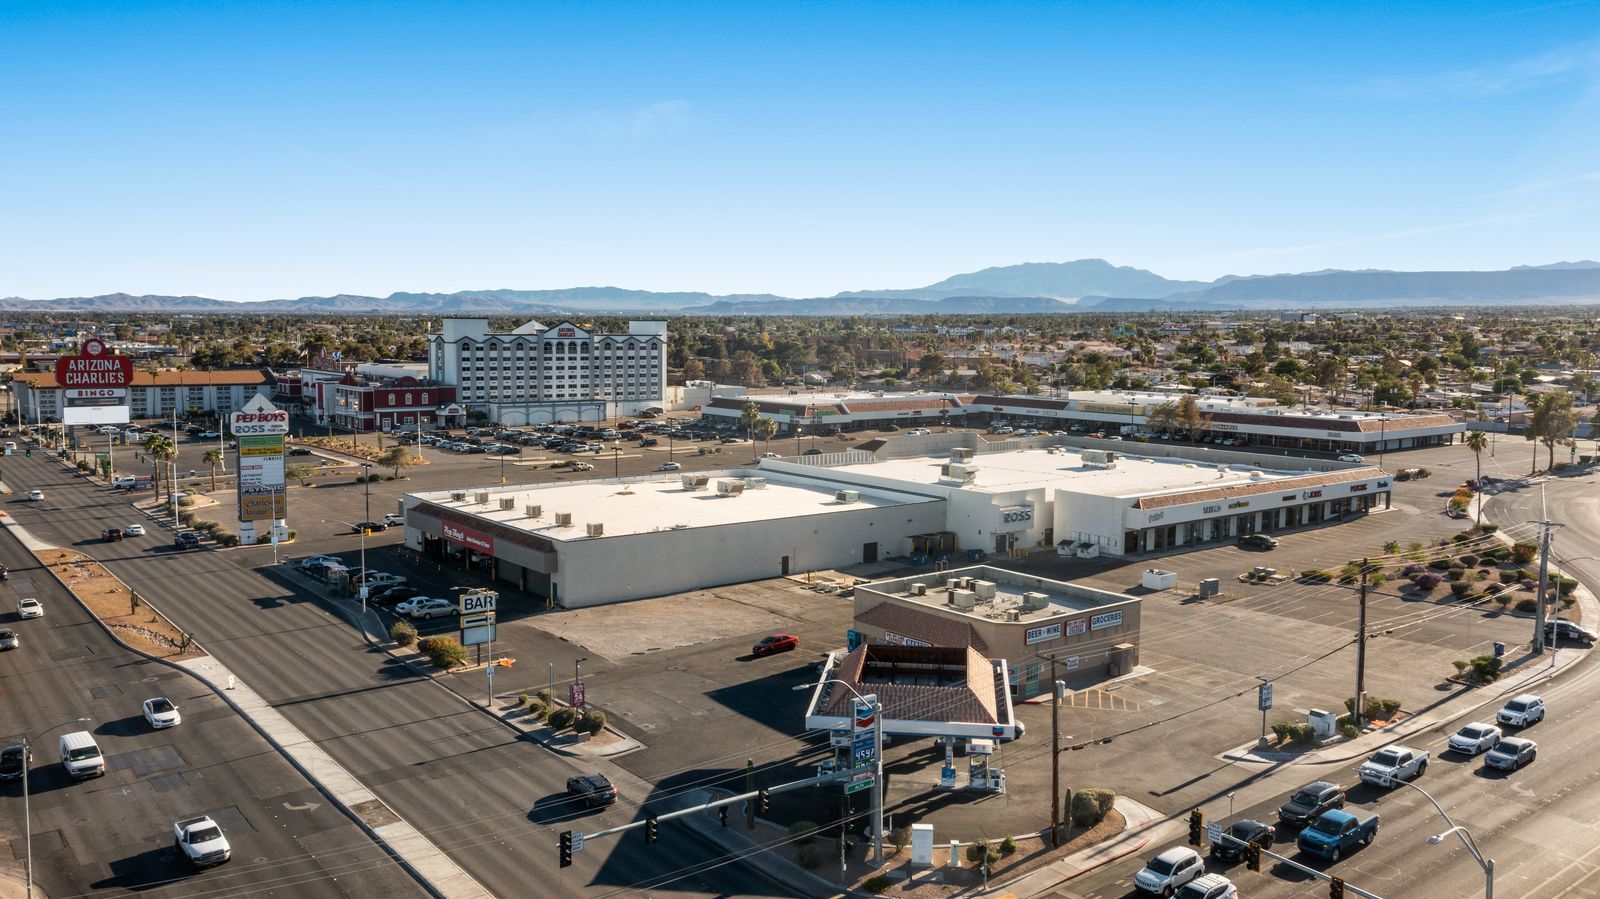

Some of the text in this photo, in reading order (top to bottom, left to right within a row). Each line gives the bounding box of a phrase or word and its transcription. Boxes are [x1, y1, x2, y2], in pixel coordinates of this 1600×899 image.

[69, 360, 121, 371] ARIZONA
[236, 413, 286, 422] PEP BOYS
[235, 425, 265, 433] ROSS
[1003, 510, 1032, 522] ROSS
[464, 596, 492, 610] BAR
[1092, 612, 1122, 624] GROCERIES
[1028, 630, 1042, 640] BEER
[1047, 626, 1060, 634] WINE
